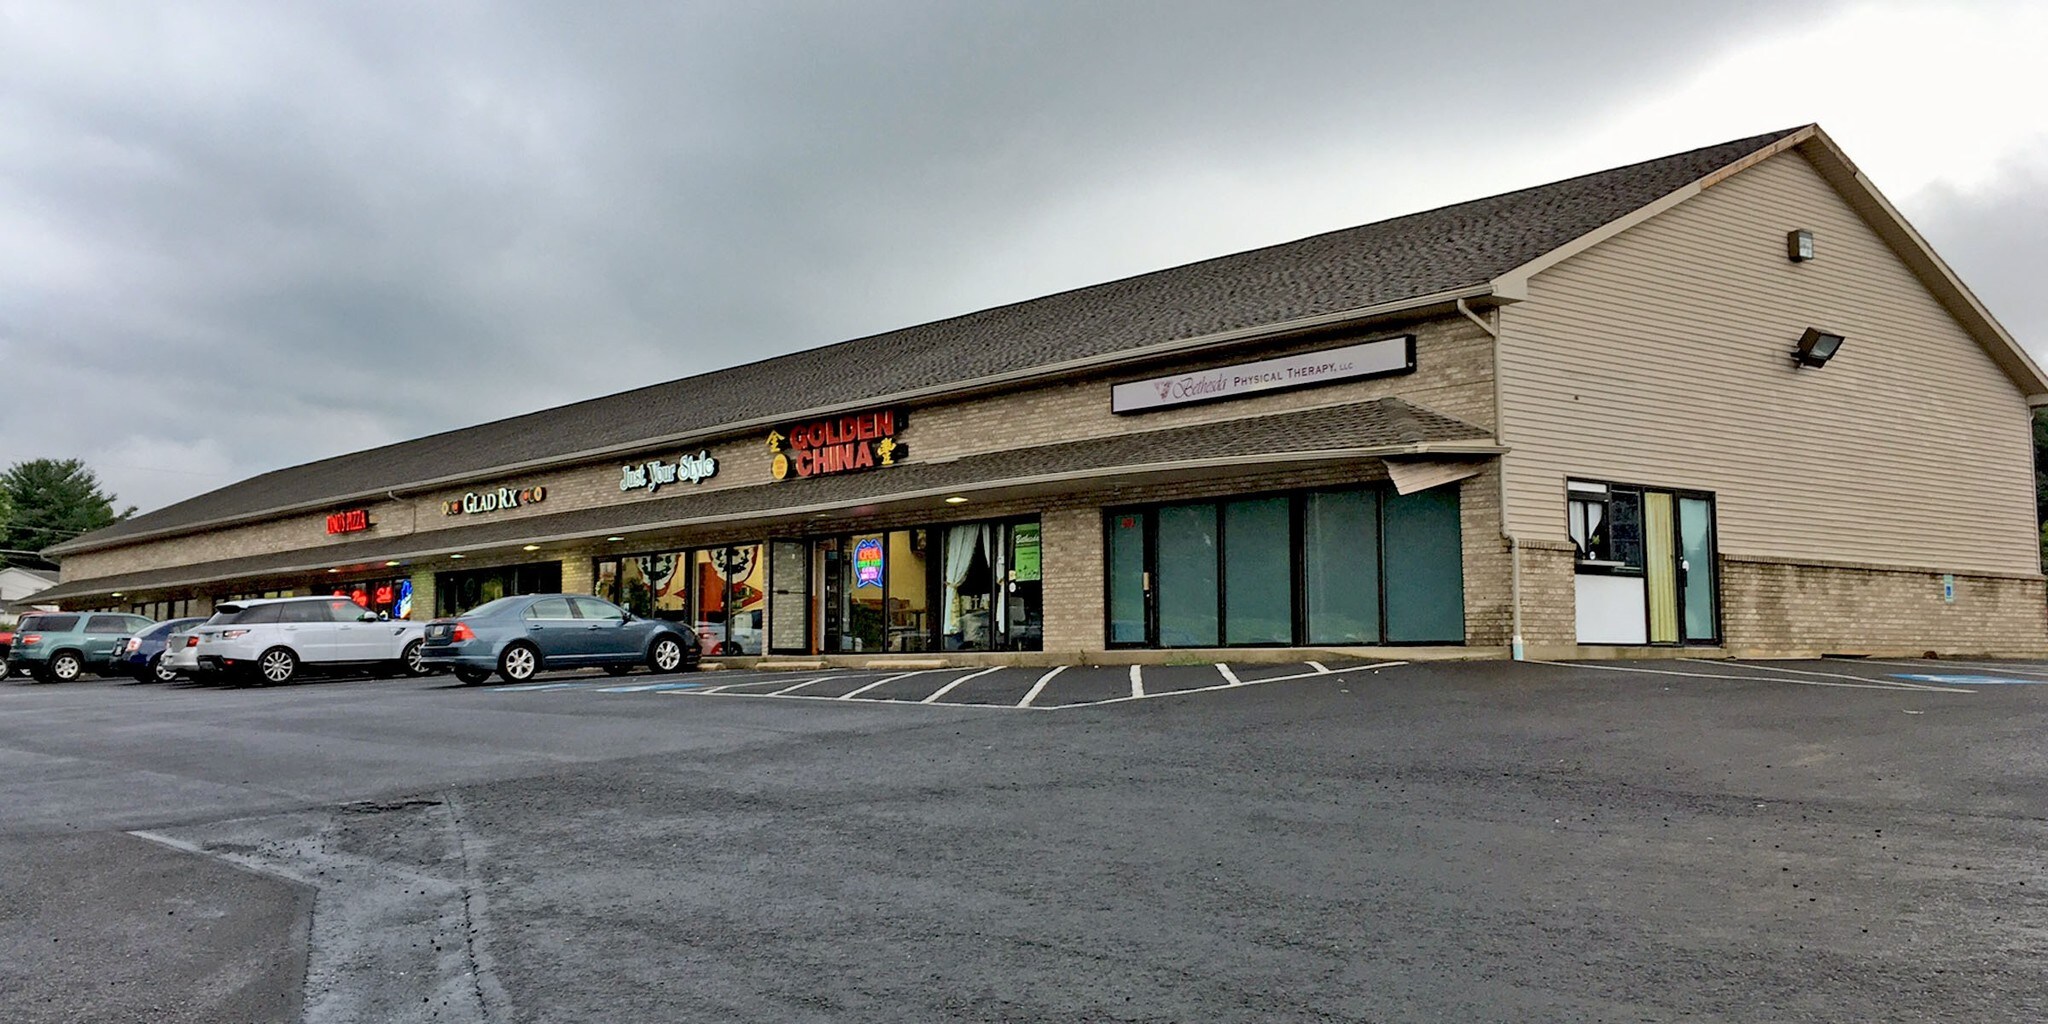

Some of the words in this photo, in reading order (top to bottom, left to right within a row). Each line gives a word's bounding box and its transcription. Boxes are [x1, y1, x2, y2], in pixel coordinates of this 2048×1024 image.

[1172, 373, 1228, 399] Bethesda
[1233, 372, 1283, 388] PHYSICAL
[1339, 361, 1353, 371] LLC
[789, 410, 895, 451] GOLDEN
[619, 463, 647, 491] Just
[647, 460, 677, 492] Your
[677, 450, 715, 484] Style
[796, 441, 874, 477] CHINA
[346, 509, 367, 531] PIZZA
[463, 492, 497, 514] GLAD
[858, 547, 881, 561] OPEN
